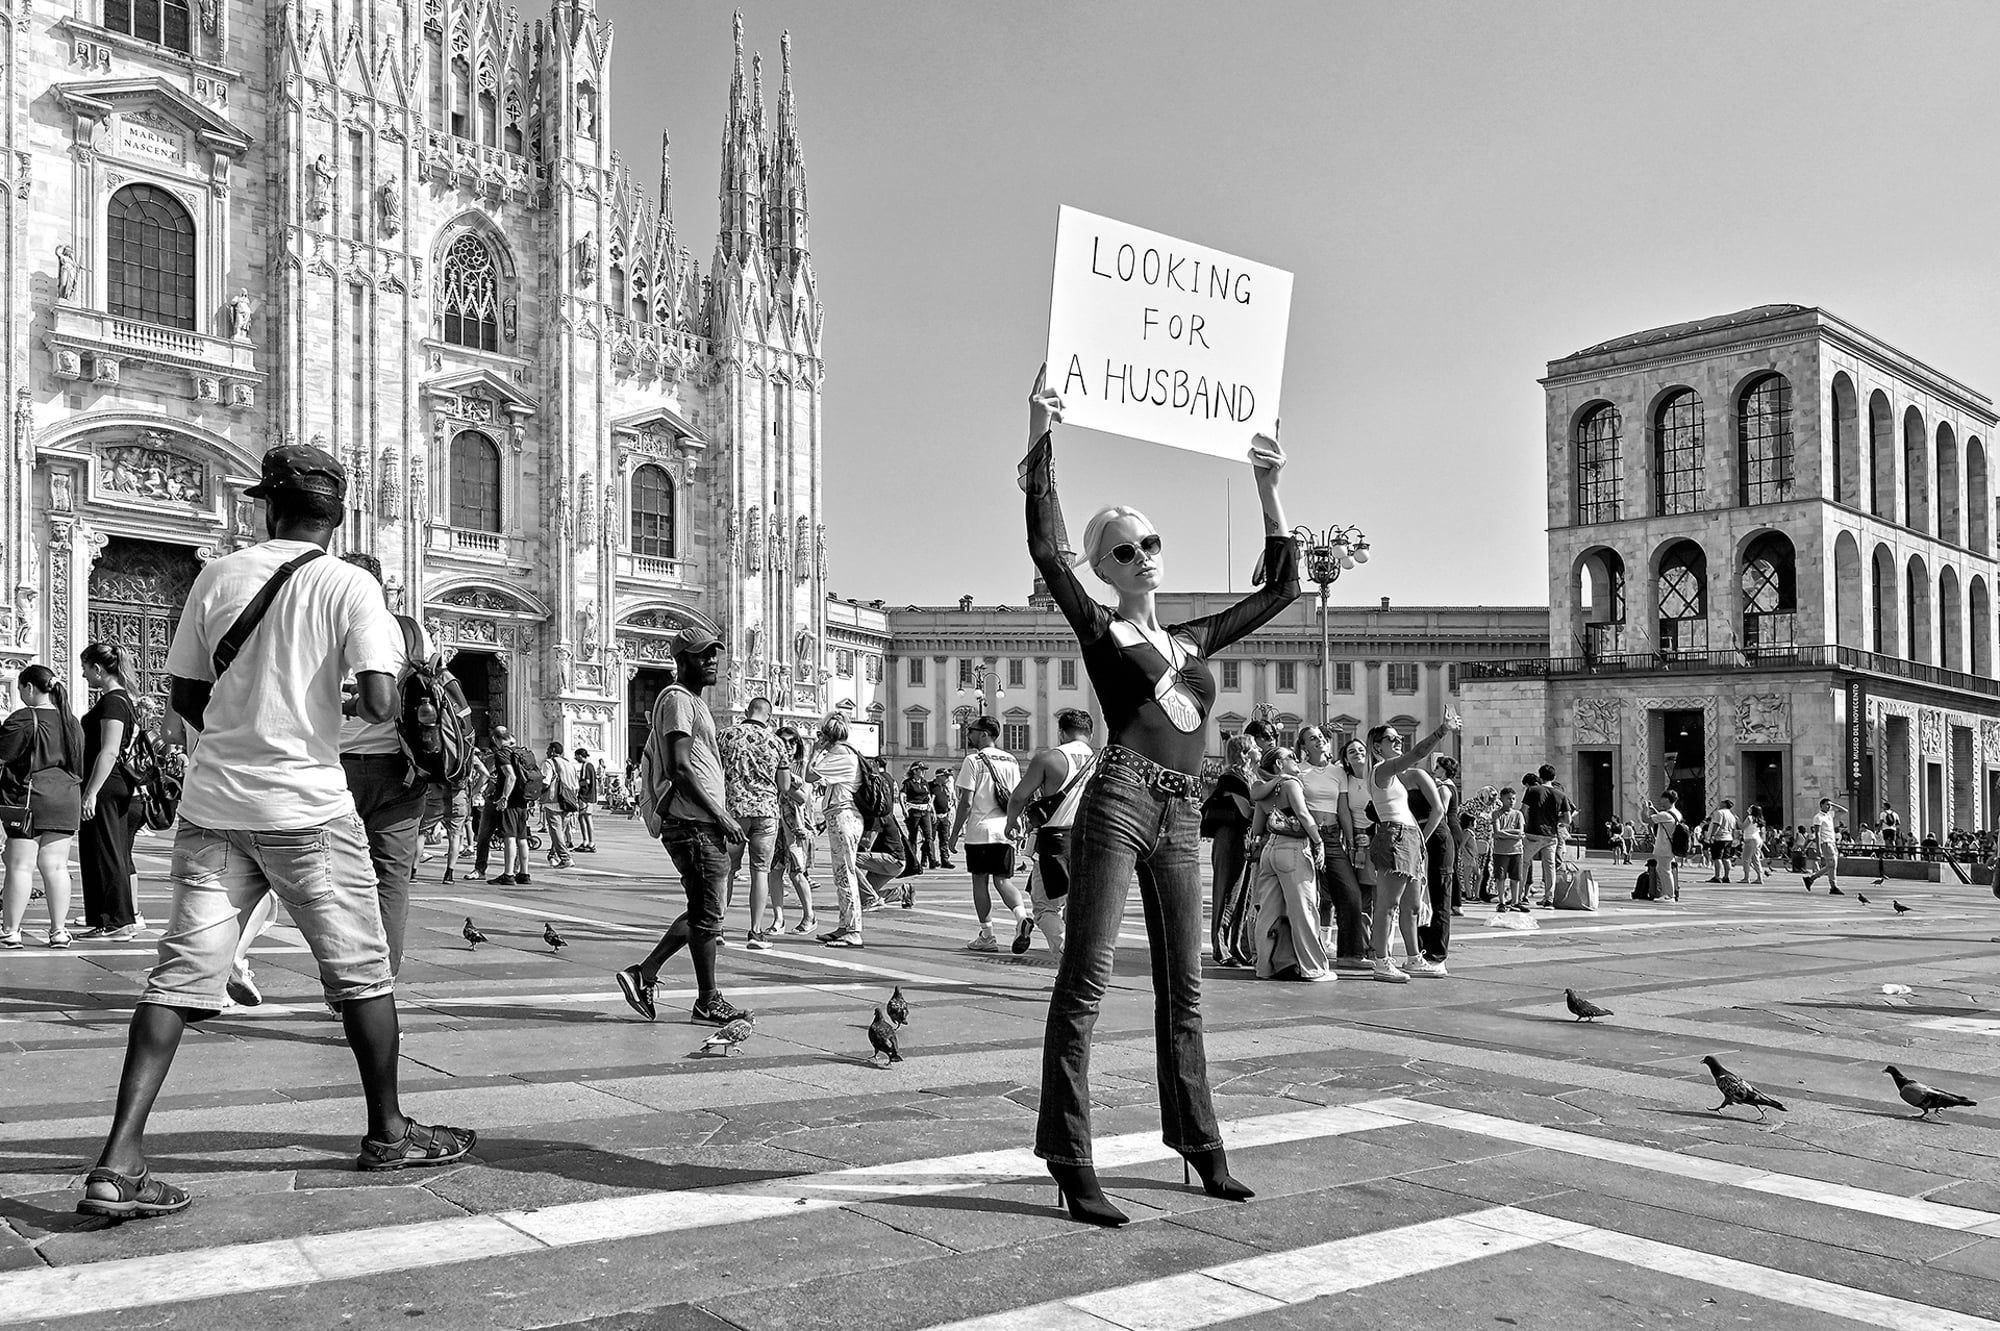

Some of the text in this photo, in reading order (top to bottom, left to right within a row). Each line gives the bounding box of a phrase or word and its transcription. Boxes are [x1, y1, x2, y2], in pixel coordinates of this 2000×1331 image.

[124, 139, 181, 160] NASCENTI
[129, 128, 175, 147] MARIAE
[1092, 236, 1251, 305] LOOKING
[1143, 307, 1210, 350] FOR
[1064, 354, 1255, 423] A HUSBAND
[1852, 683, 1860, 723] NOVECENTO
[1852, 724, 1860, 736] DEL
[1852, 737, 1860, 760] MUSEO
